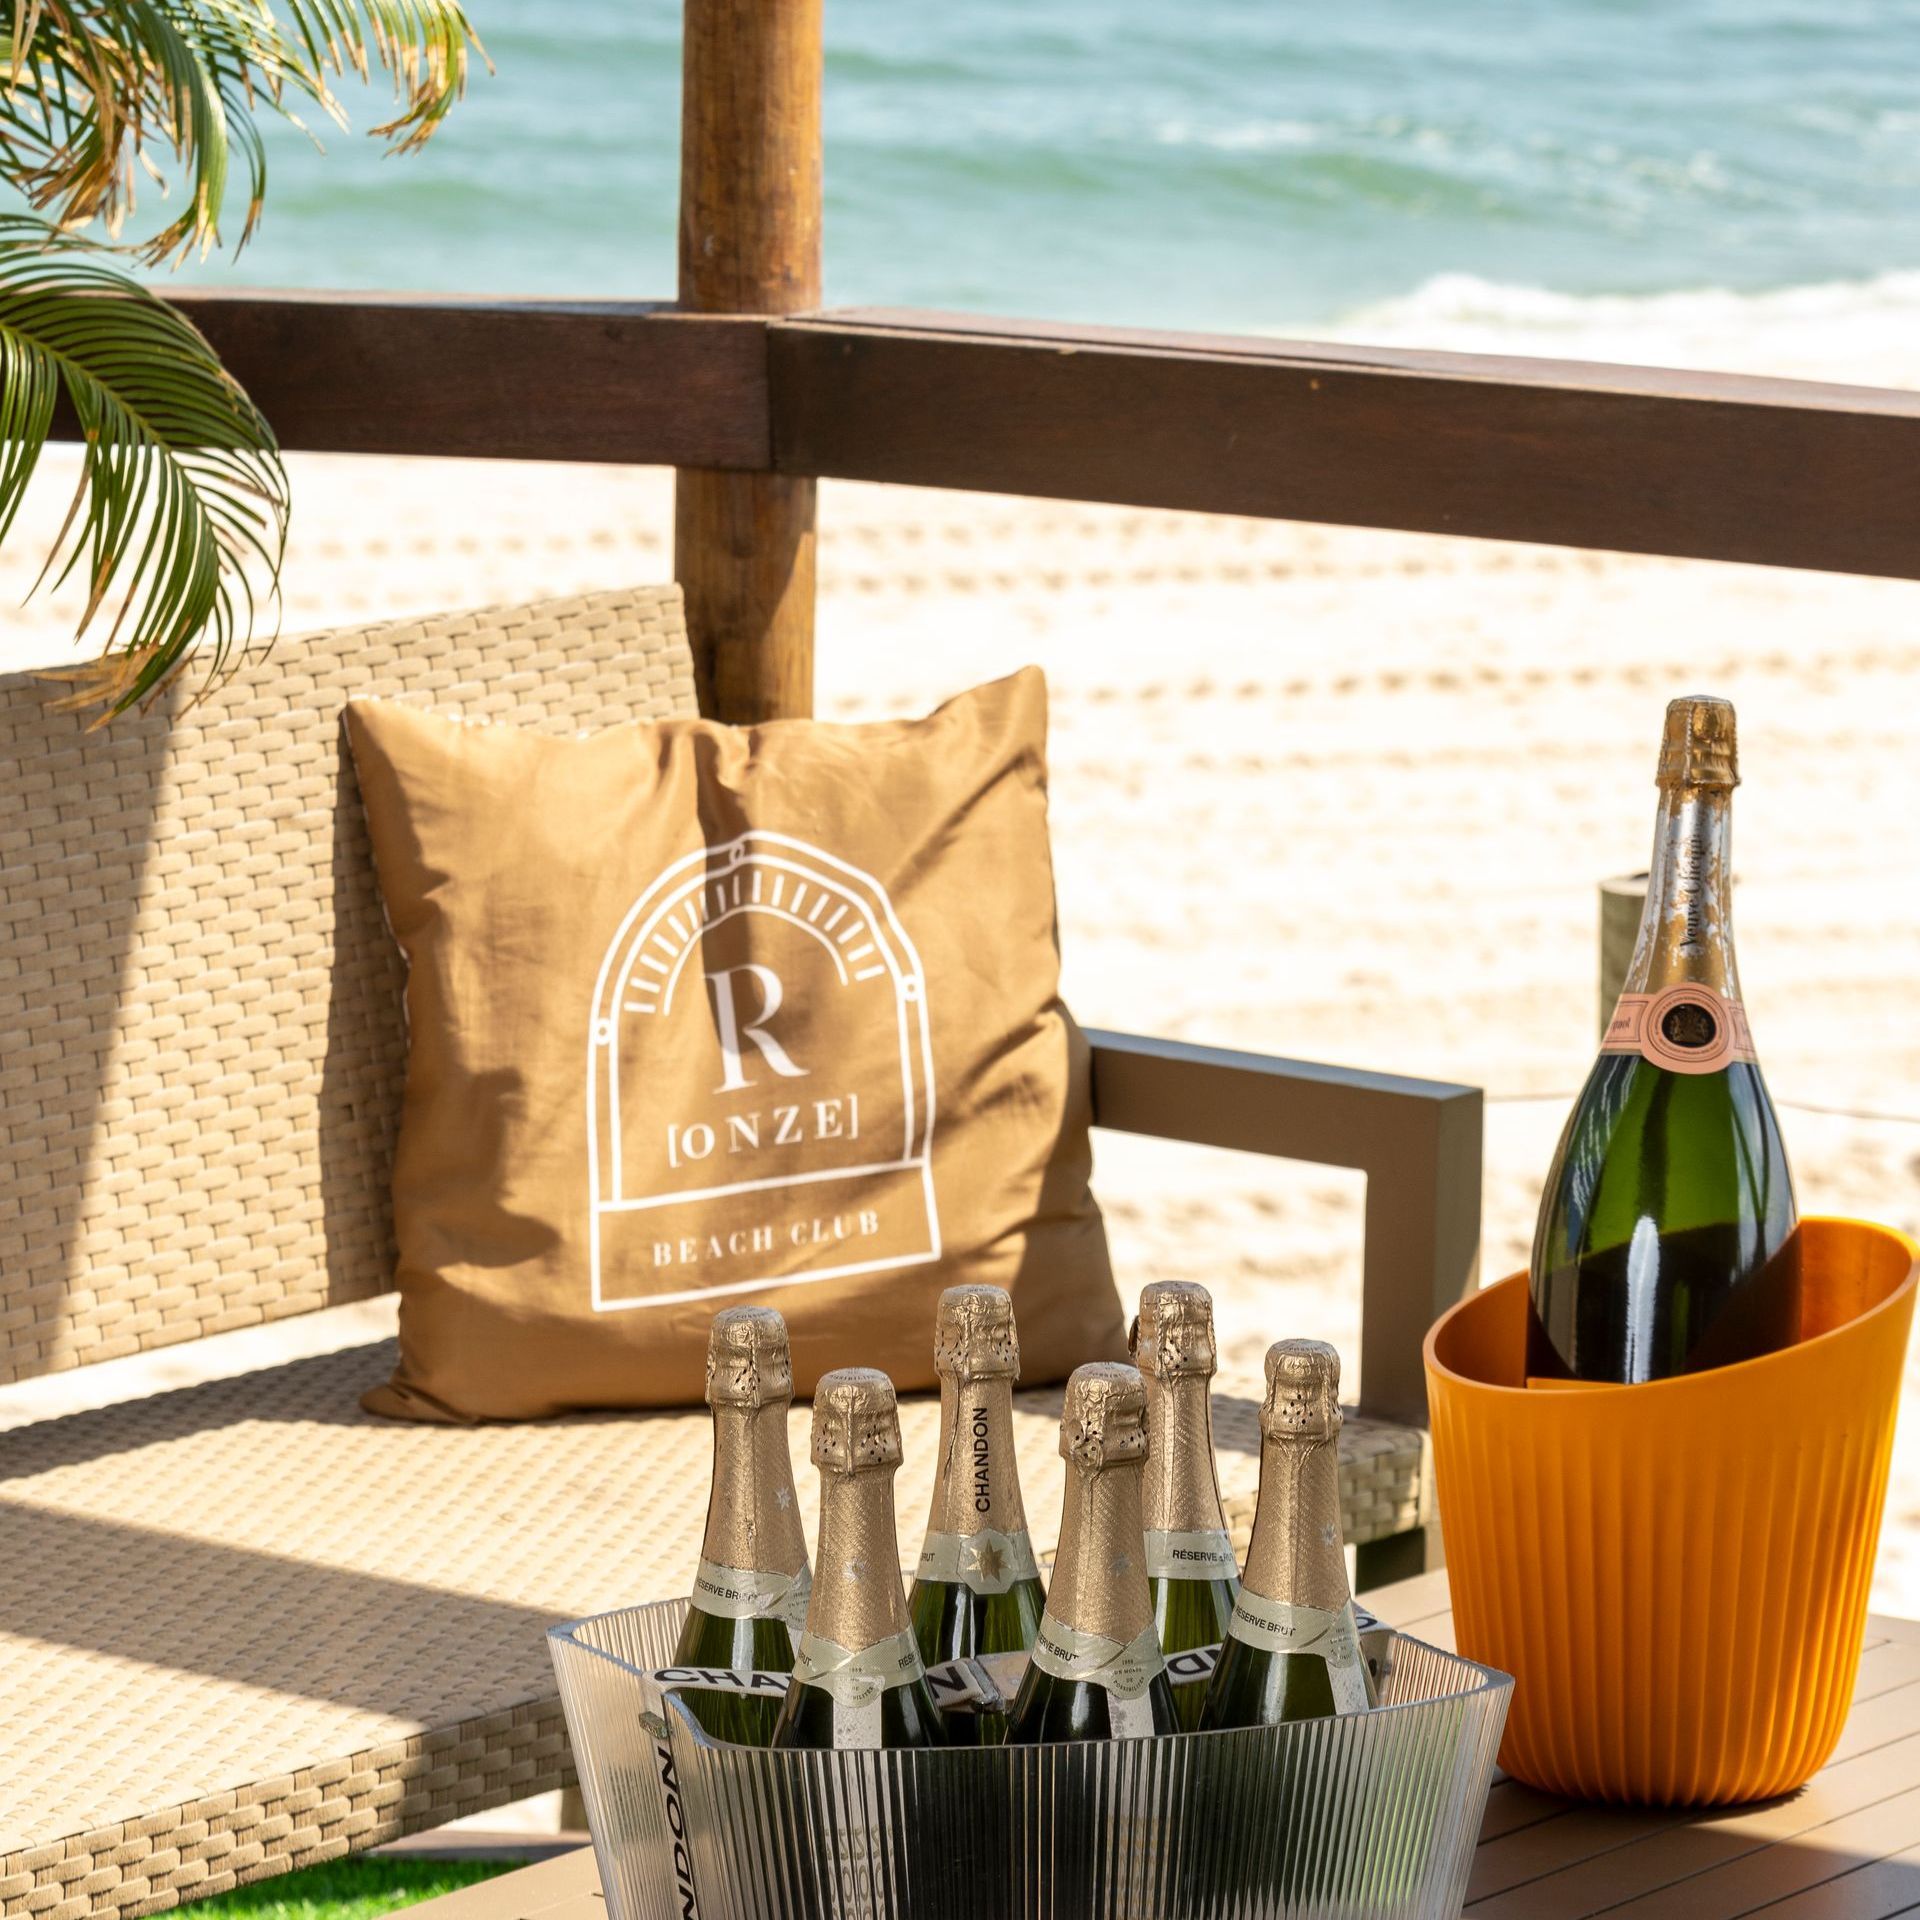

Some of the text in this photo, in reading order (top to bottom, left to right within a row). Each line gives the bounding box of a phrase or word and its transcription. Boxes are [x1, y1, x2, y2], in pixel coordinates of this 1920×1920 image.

[704, 964, 811, 1095] R
[653, 1208, 880, 1267] BEACH CLUB
[973, 1407, 991, 1513] CHANDON
[1053, 1646, 1080, 1662] BRUT
[1266, 1621, 1297, 1638] BRUT
